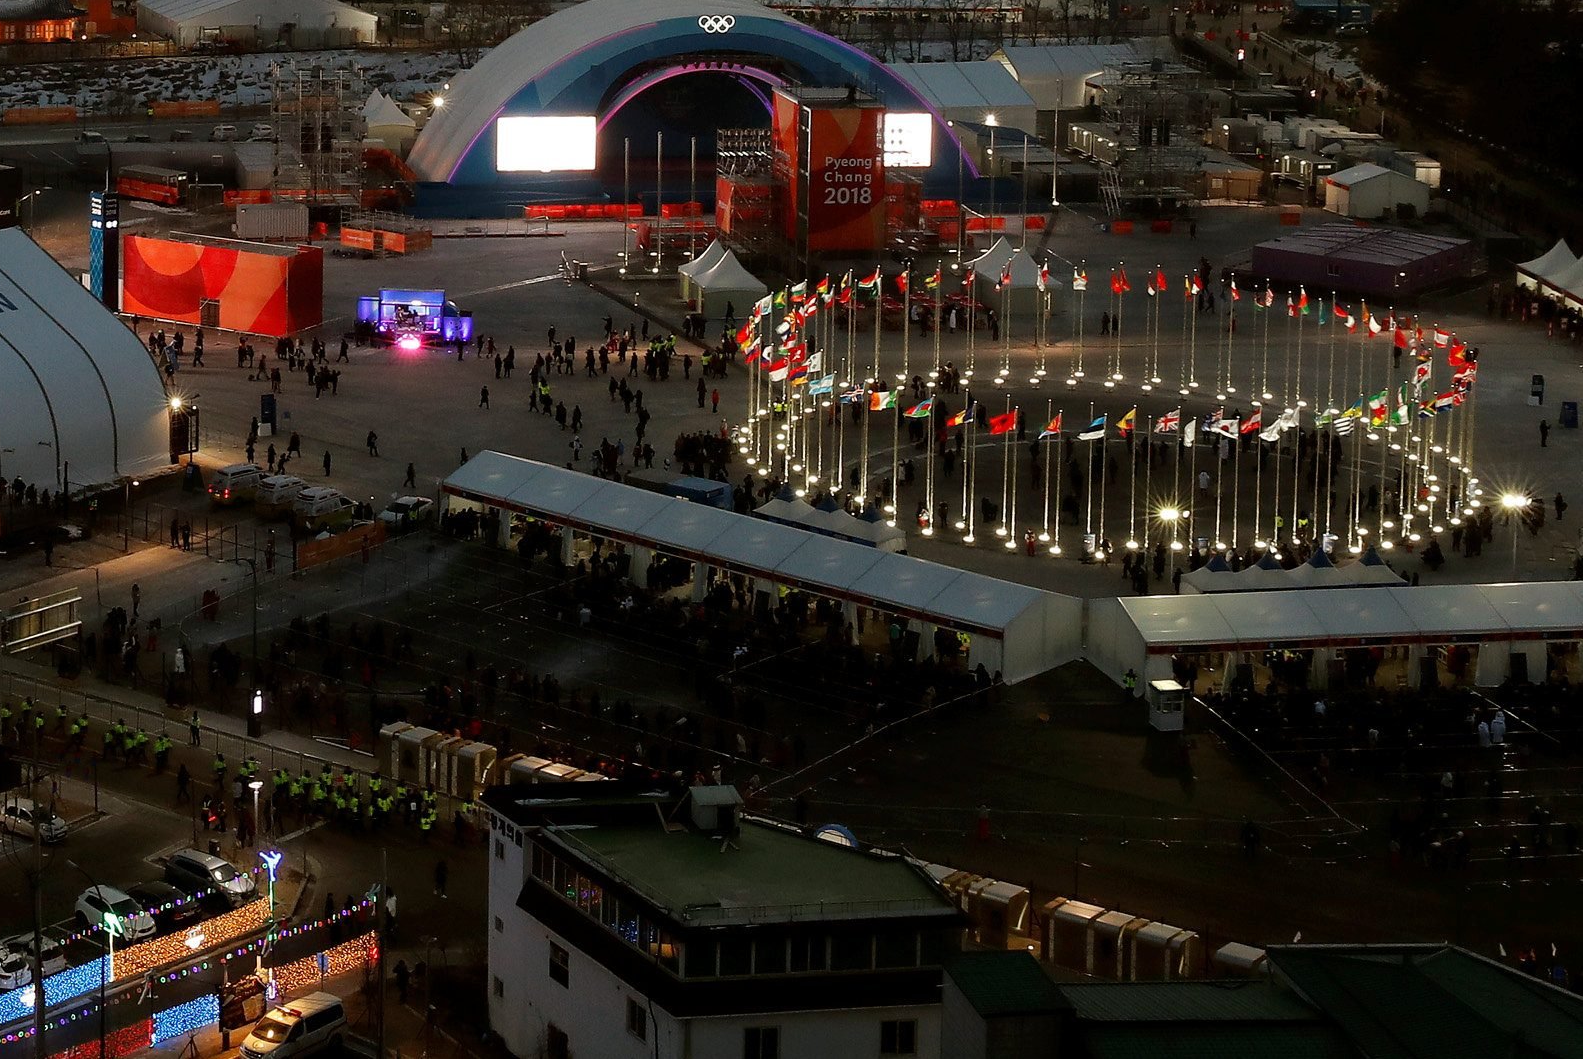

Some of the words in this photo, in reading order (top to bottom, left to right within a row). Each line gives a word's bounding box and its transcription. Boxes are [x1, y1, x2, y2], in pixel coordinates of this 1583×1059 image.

[825, 156, 873, 169] Pyeong
[824, 171, 872, 184] Chang
[824, 187, 872, 205] 2018
